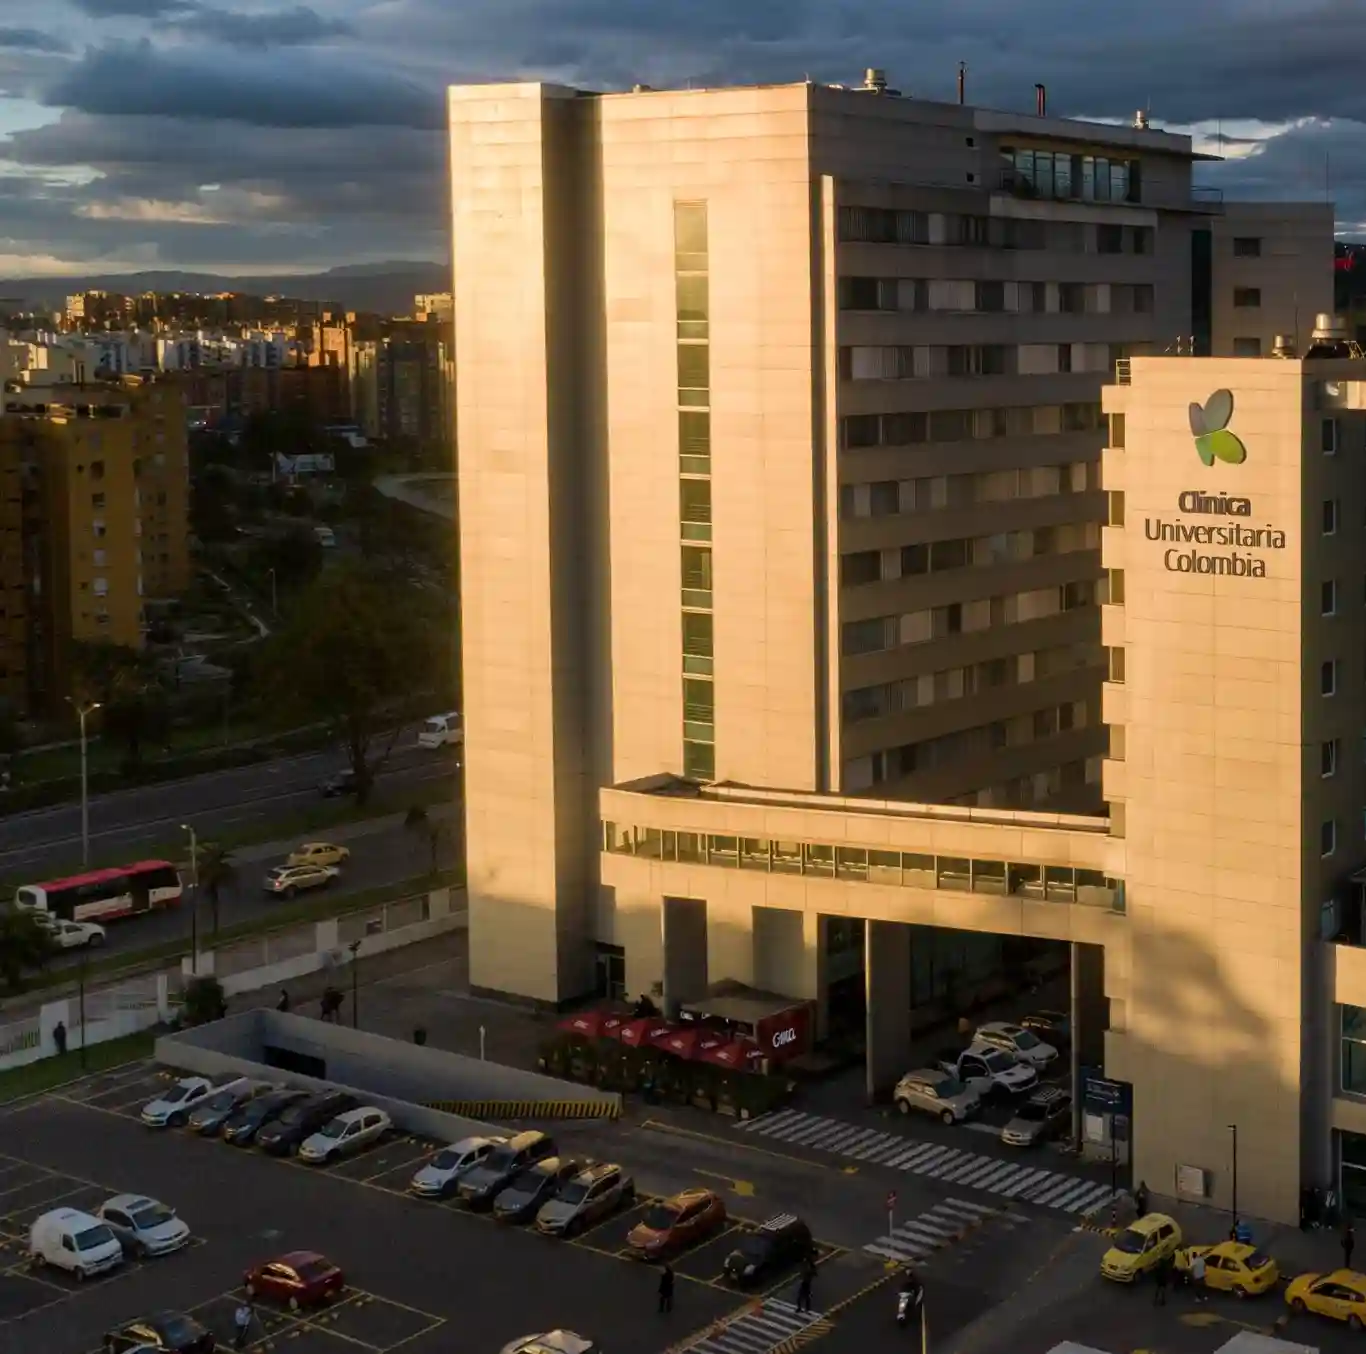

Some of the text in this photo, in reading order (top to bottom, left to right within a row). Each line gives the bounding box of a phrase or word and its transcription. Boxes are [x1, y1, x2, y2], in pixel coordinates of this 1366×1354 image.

[1178, 490, 1251, 517] Clínica
[1145, 518, 1286, 549] Universitaria
[1164, 549, 1266, 578] Colombia
